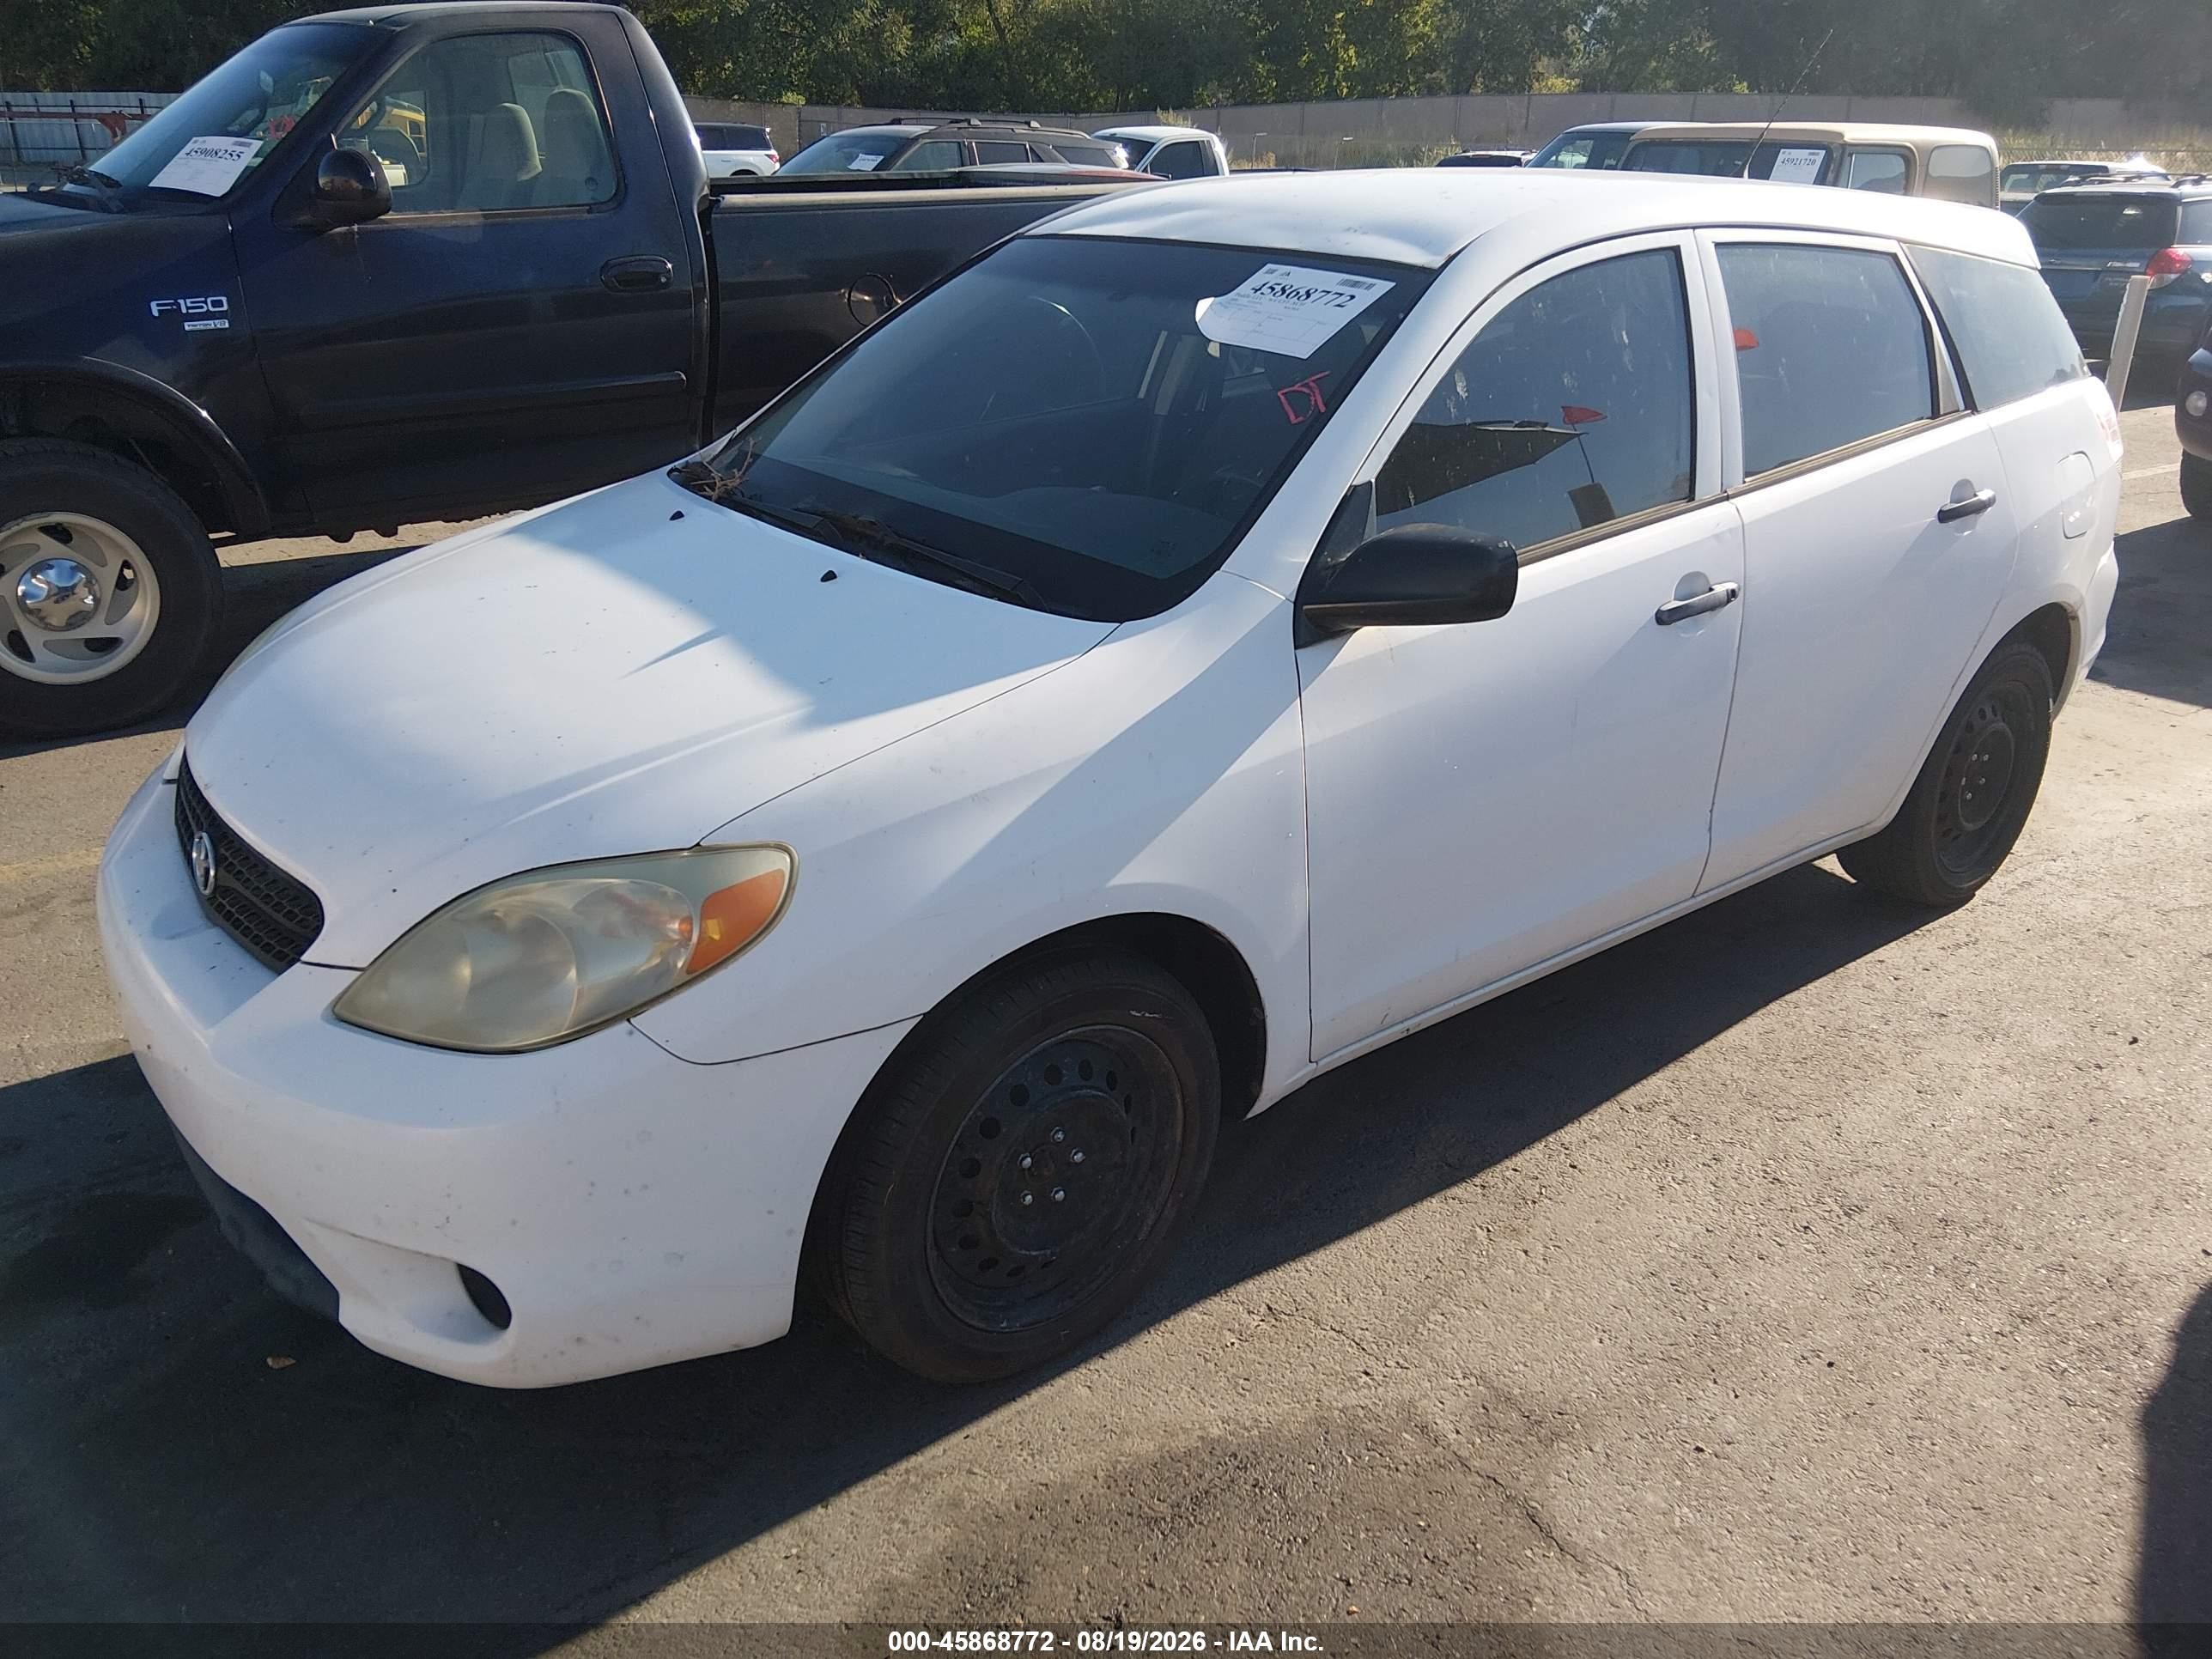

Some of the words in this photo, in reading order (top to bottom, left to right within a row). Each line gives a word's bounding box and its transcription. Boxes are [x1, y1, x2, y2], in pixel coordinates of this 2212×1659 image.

[185, 147, 245, 161] 45908255
[1781, 157, 1816, 166] 45921720
[1251, 281, 1356, 308] 45868772
[150, 296, 228, 317] F-150
